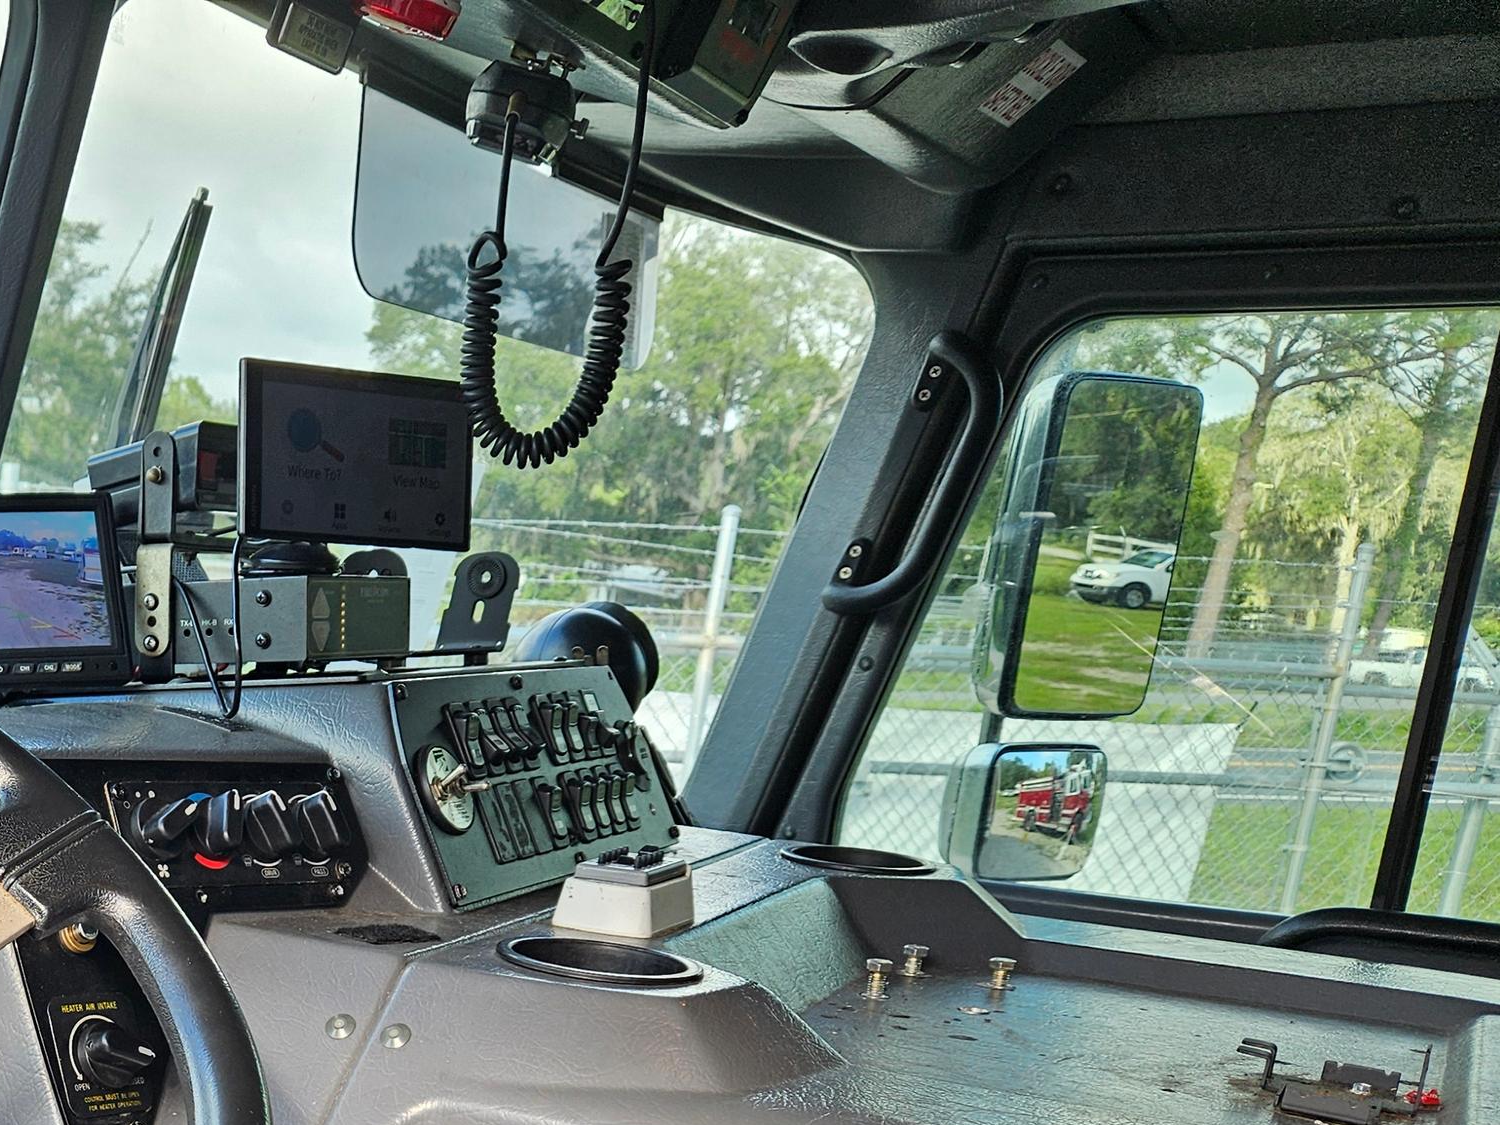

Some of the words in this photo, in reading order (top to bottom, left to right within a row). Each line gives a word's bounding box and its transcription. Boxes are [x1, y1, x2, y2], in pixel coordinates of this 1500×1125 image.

[288, 464, 321, 479] Where
[324, 467, 342, 481] To?
[393, 475, 417, 488] View
[419, 476, 440, 490] Map
[61, 1004, 83, 1013] HEATER
[85, 1003, 95, 1011] AIR
[97, 1001, 118, 1010] INTAKE
[74, 1083, 91, 1092] OPEN
